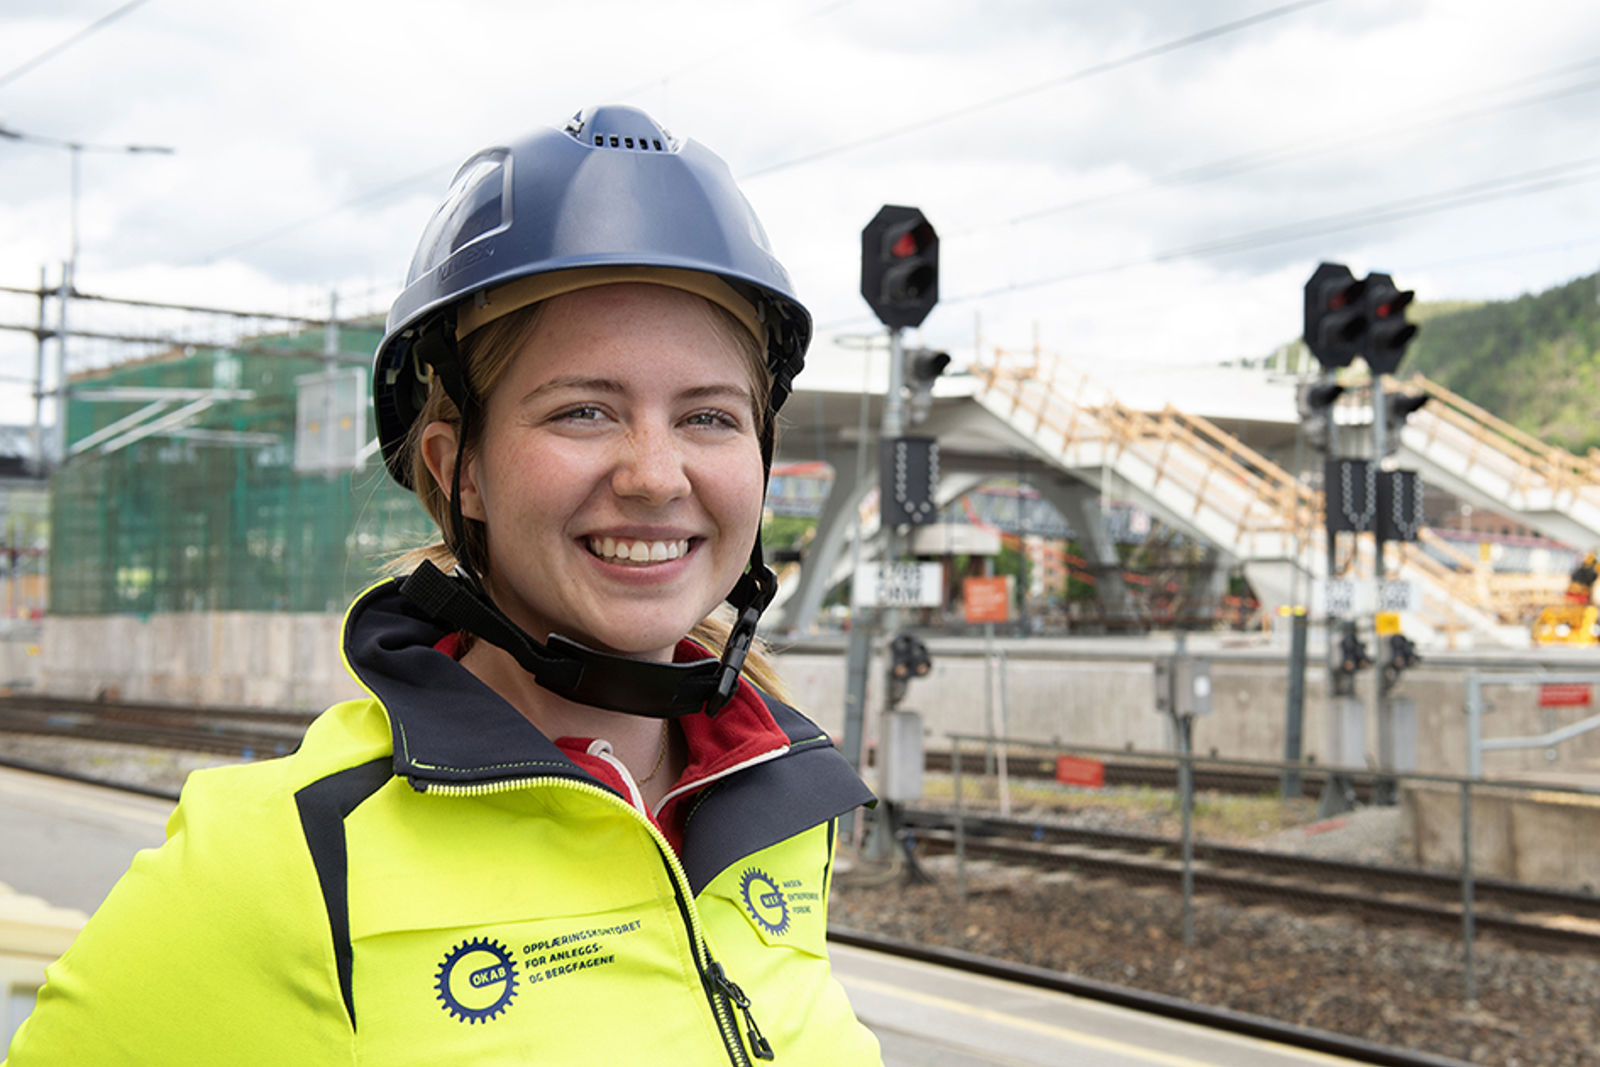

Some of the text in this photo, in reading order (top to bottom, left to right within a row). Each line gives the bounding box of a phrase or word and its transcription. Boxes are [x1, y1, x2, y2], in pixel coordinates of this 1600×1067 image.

[522, 919, 641, 955] OPPLÆRINGSKONTORET
[525, 942, 603, 969] FOR ANLEGGS-
[528, 954, 615, 984] OG BERGFAGENE
[472, 966, 506, 986] OKAB
